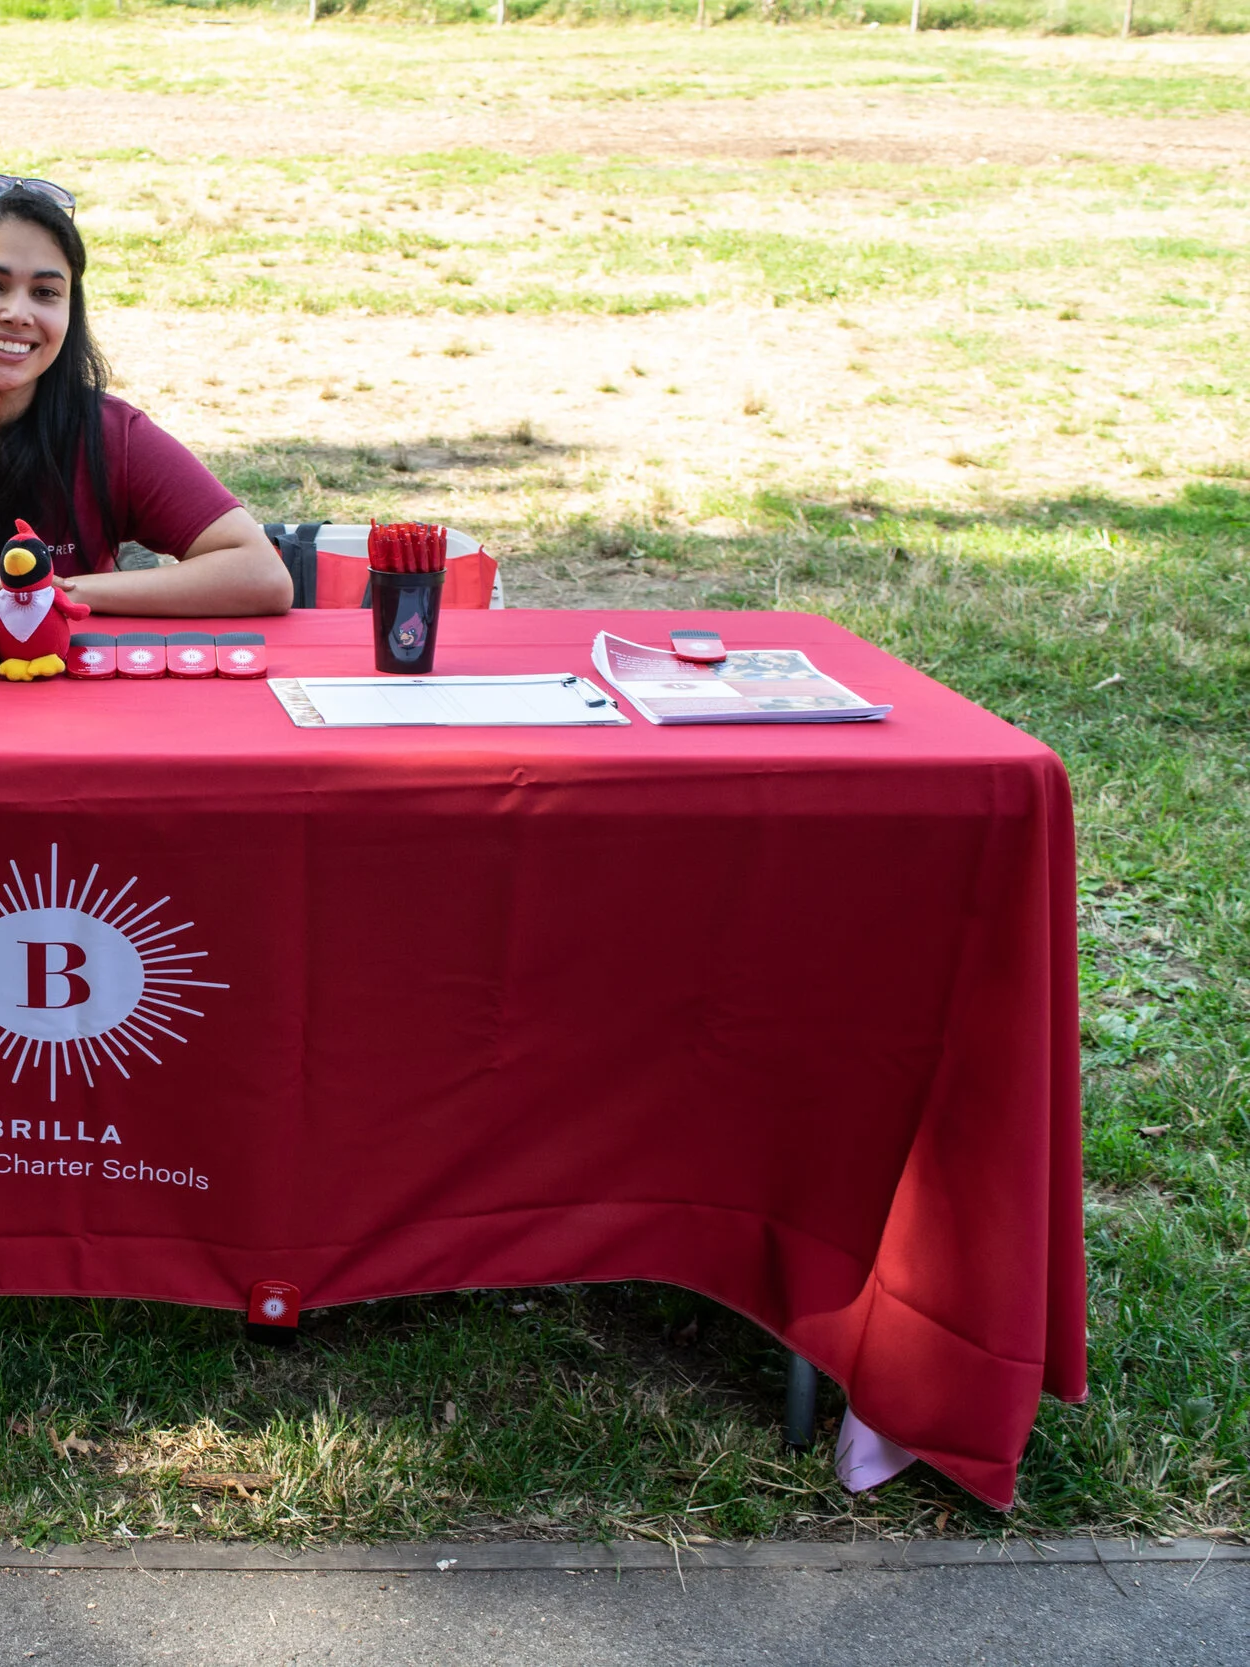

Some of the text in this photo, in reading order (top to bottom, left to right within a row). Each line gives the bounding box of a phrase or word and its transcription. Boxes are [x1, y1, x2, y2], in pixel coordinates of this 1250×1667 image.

[47, 543, 76, 556] PREP
[15, 940, 91, 1009] B
[102, 1159, 209, 1190] Schools
